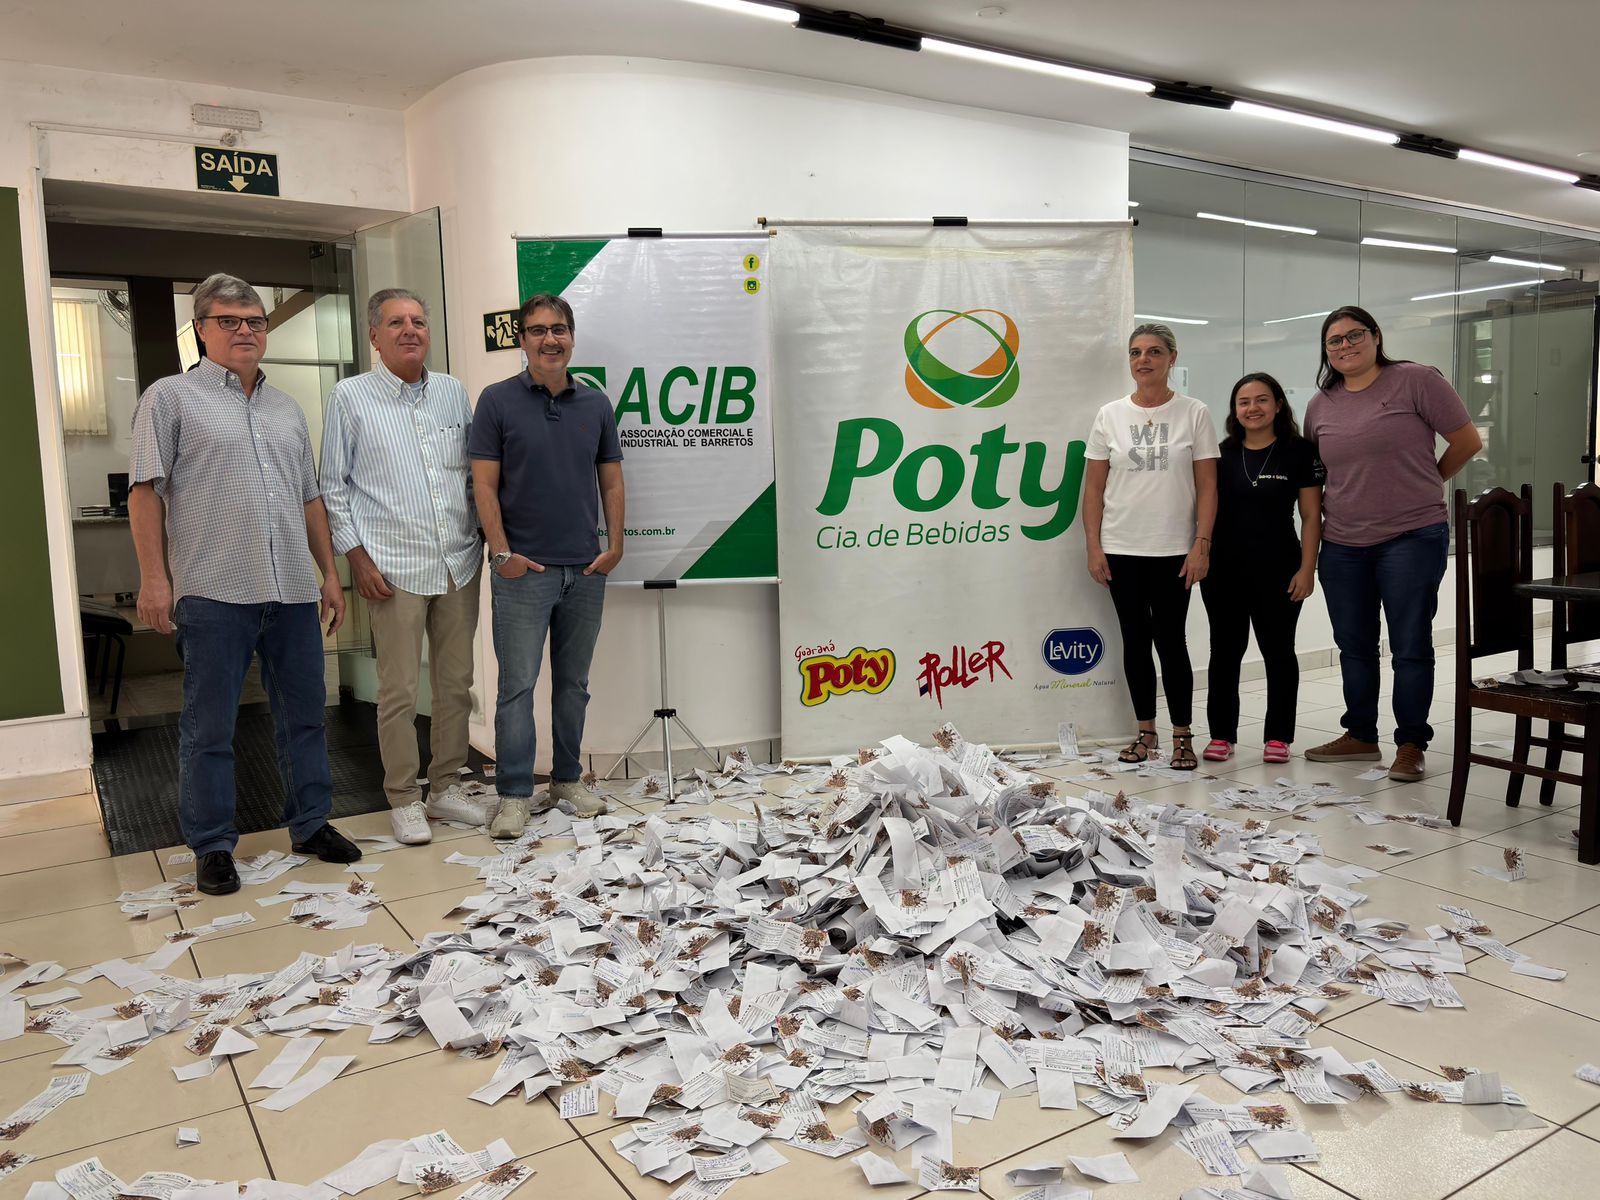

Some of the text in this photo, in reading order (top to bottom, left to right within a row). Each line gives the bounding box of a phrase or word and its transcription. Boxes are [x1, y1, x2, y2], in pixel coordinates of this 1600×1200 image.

[200, 151, 274, 177] SAÍDA
[614, 365, 757, 426] ACIB
[620, 427, 754, 440] ASSOCIAÇÃO COMERCIAL E
[620, 437, 754, 448] INDUSTRIAL DE BARRETOS
[815, 416, 1088, 541] Poty
[816, 519, 1011, 550] Cia. de Bebidas
[794, 639, 836, 662] Guaraná
[806, 653, 889, 701] Poty
